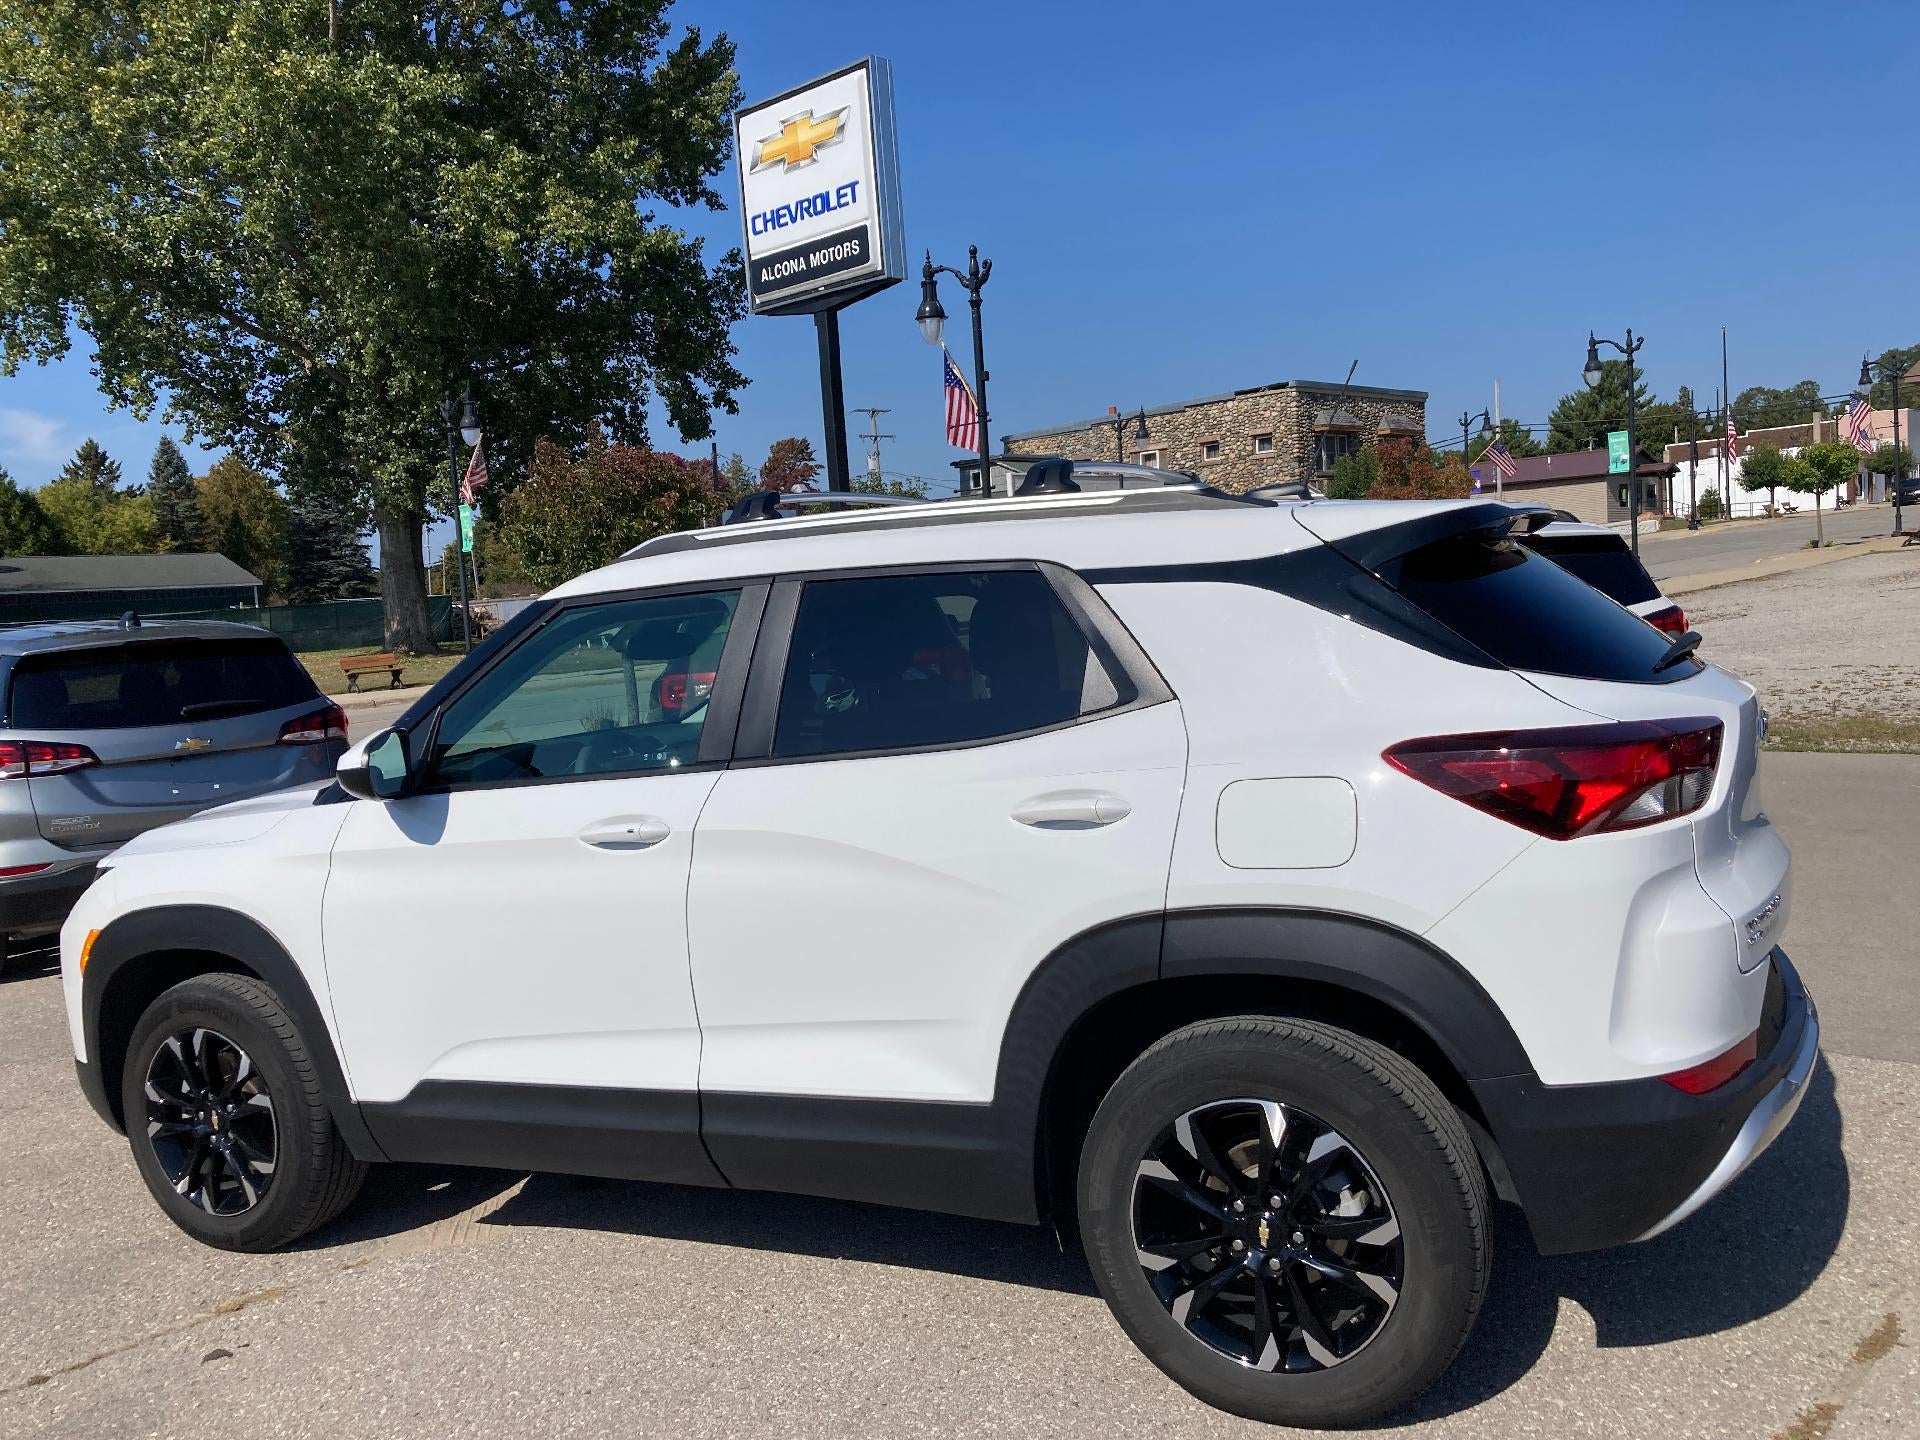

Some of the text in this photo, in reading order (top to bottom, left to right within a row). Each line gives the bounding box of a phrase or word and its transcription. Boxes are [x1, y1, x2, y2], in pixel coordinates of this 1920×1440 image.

[752, 181, 859, 236] CHEVROLET
[761, 239, 860, 282] ALCONA MOTORS
